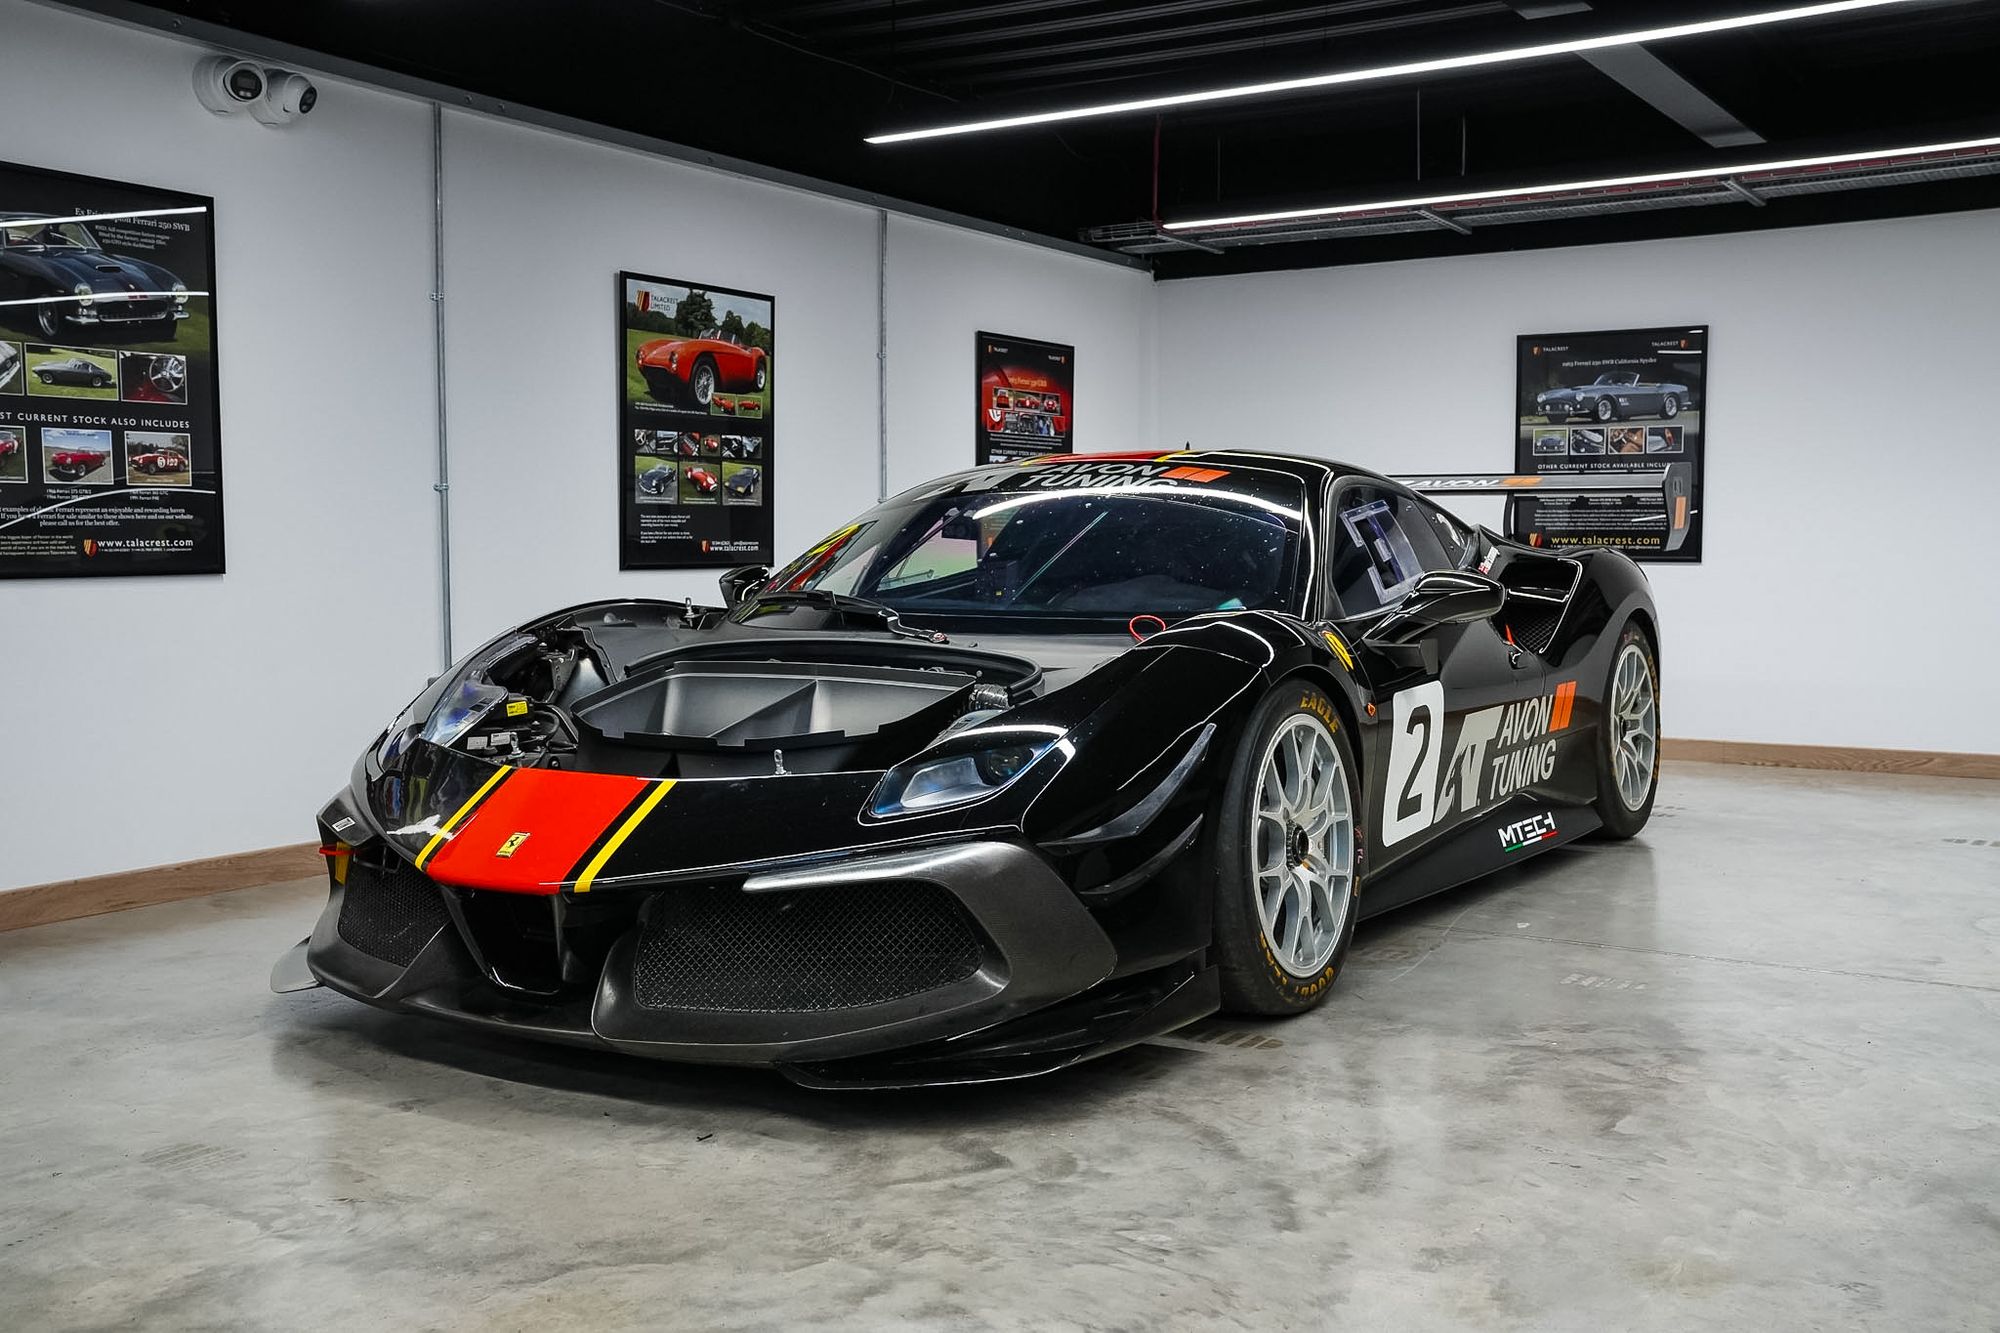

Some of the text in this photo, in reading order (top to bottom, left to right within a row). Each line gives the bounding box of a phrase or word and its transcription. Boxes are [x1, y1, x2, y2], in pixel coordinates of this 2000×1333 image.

[132, 217, 157, 227] Ferrari
[158, 221, 172, 230] 250
[172, 223, 190, 232] SWB
[17, 412, 68, 422] CURRENT
[72, 415, 107, 425] STOCK
[111, 417, 136, 426] ALSO
[141, 418, 190, 429] INCLUDES
[1042, 463, 1169, 476] AVON
[1414, 479, 1500, 487] AVON
[108, 507, 134, 515] enjoyable
[144, 506, 170, 515] rewarding
[40, 519, 57, 527] please
[97, 538, 194, 547] www.talacrest.com
[1551, 535, 1661, 545] www.talacrest.com
[709, 544, 759, 552] www.talacrest.com
[1299, 689, 1340, 734] EAGLE
[1497, 694, 1554, 749] AVON
[1396, 704, 1432, 822] 2
[1489, 738, 1557, 801] TUNING
